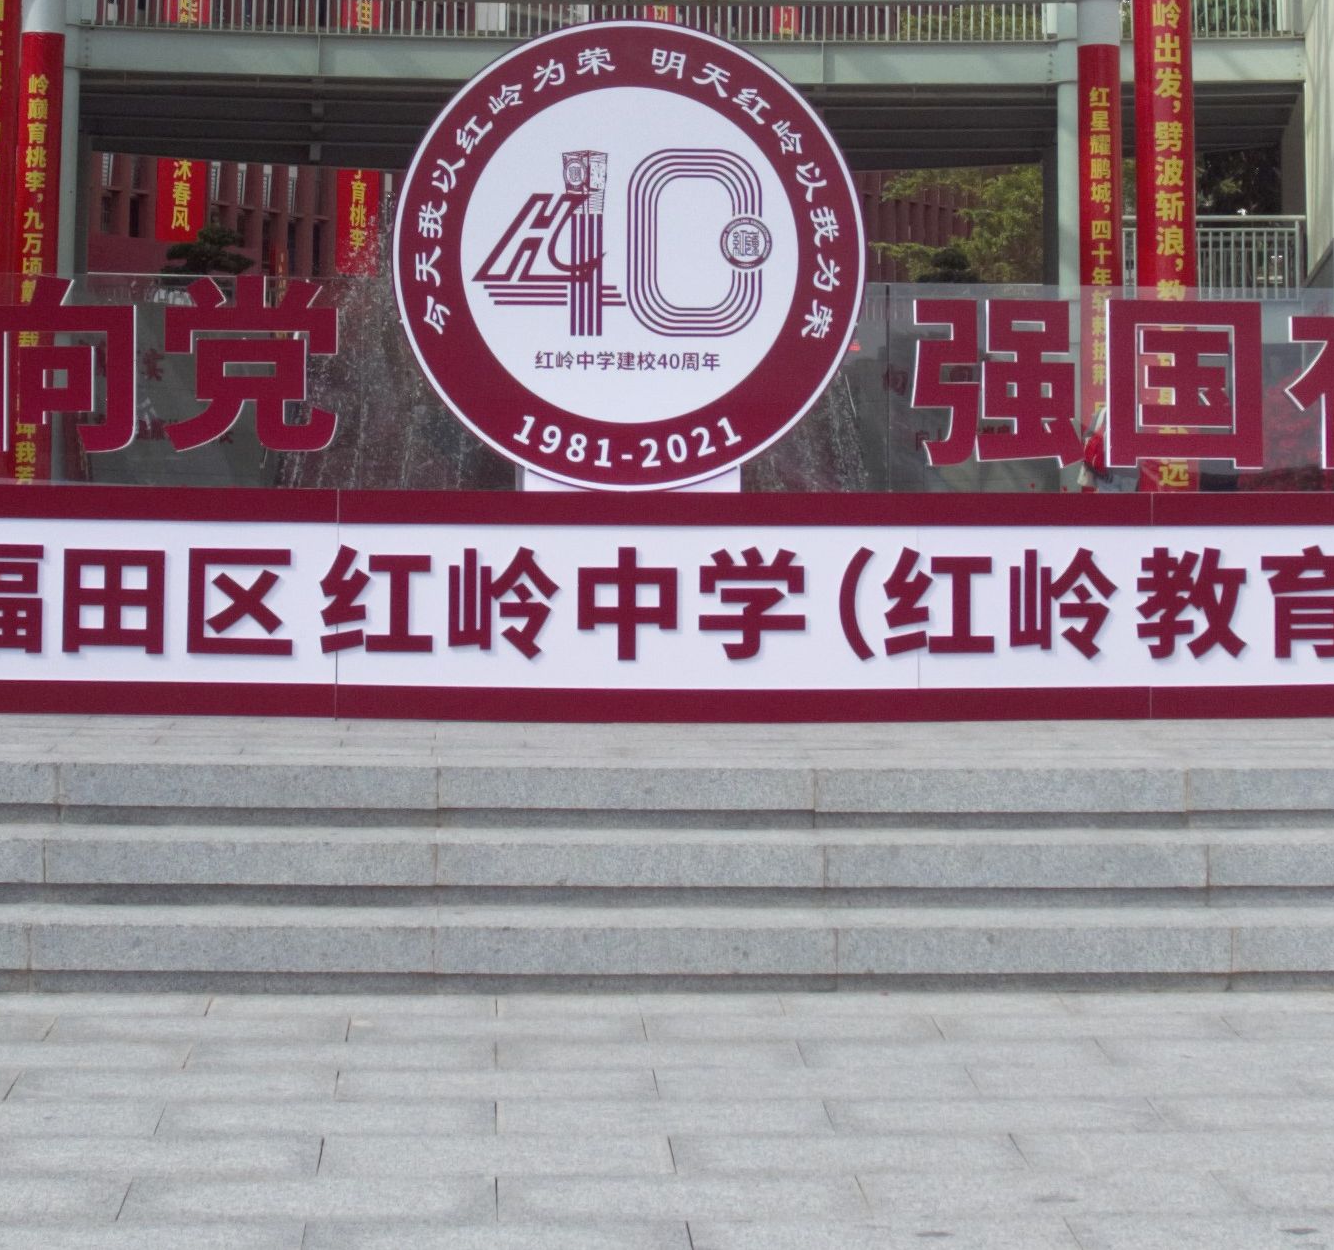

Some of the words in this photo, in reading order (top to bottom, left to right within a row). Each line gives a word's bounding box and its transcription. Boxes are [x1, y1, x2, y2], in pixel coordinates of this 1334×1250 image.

[349, 170, 367, 253] 育桃李
[414, 47, 617, 336] 今天我以红岭为荣
[651, 47, 842, 340] 明天红岭以我为荣
[534, 350, 721, 372] 红岭中学建校40周年
[512, 414, 743, 469] 1981-2021
